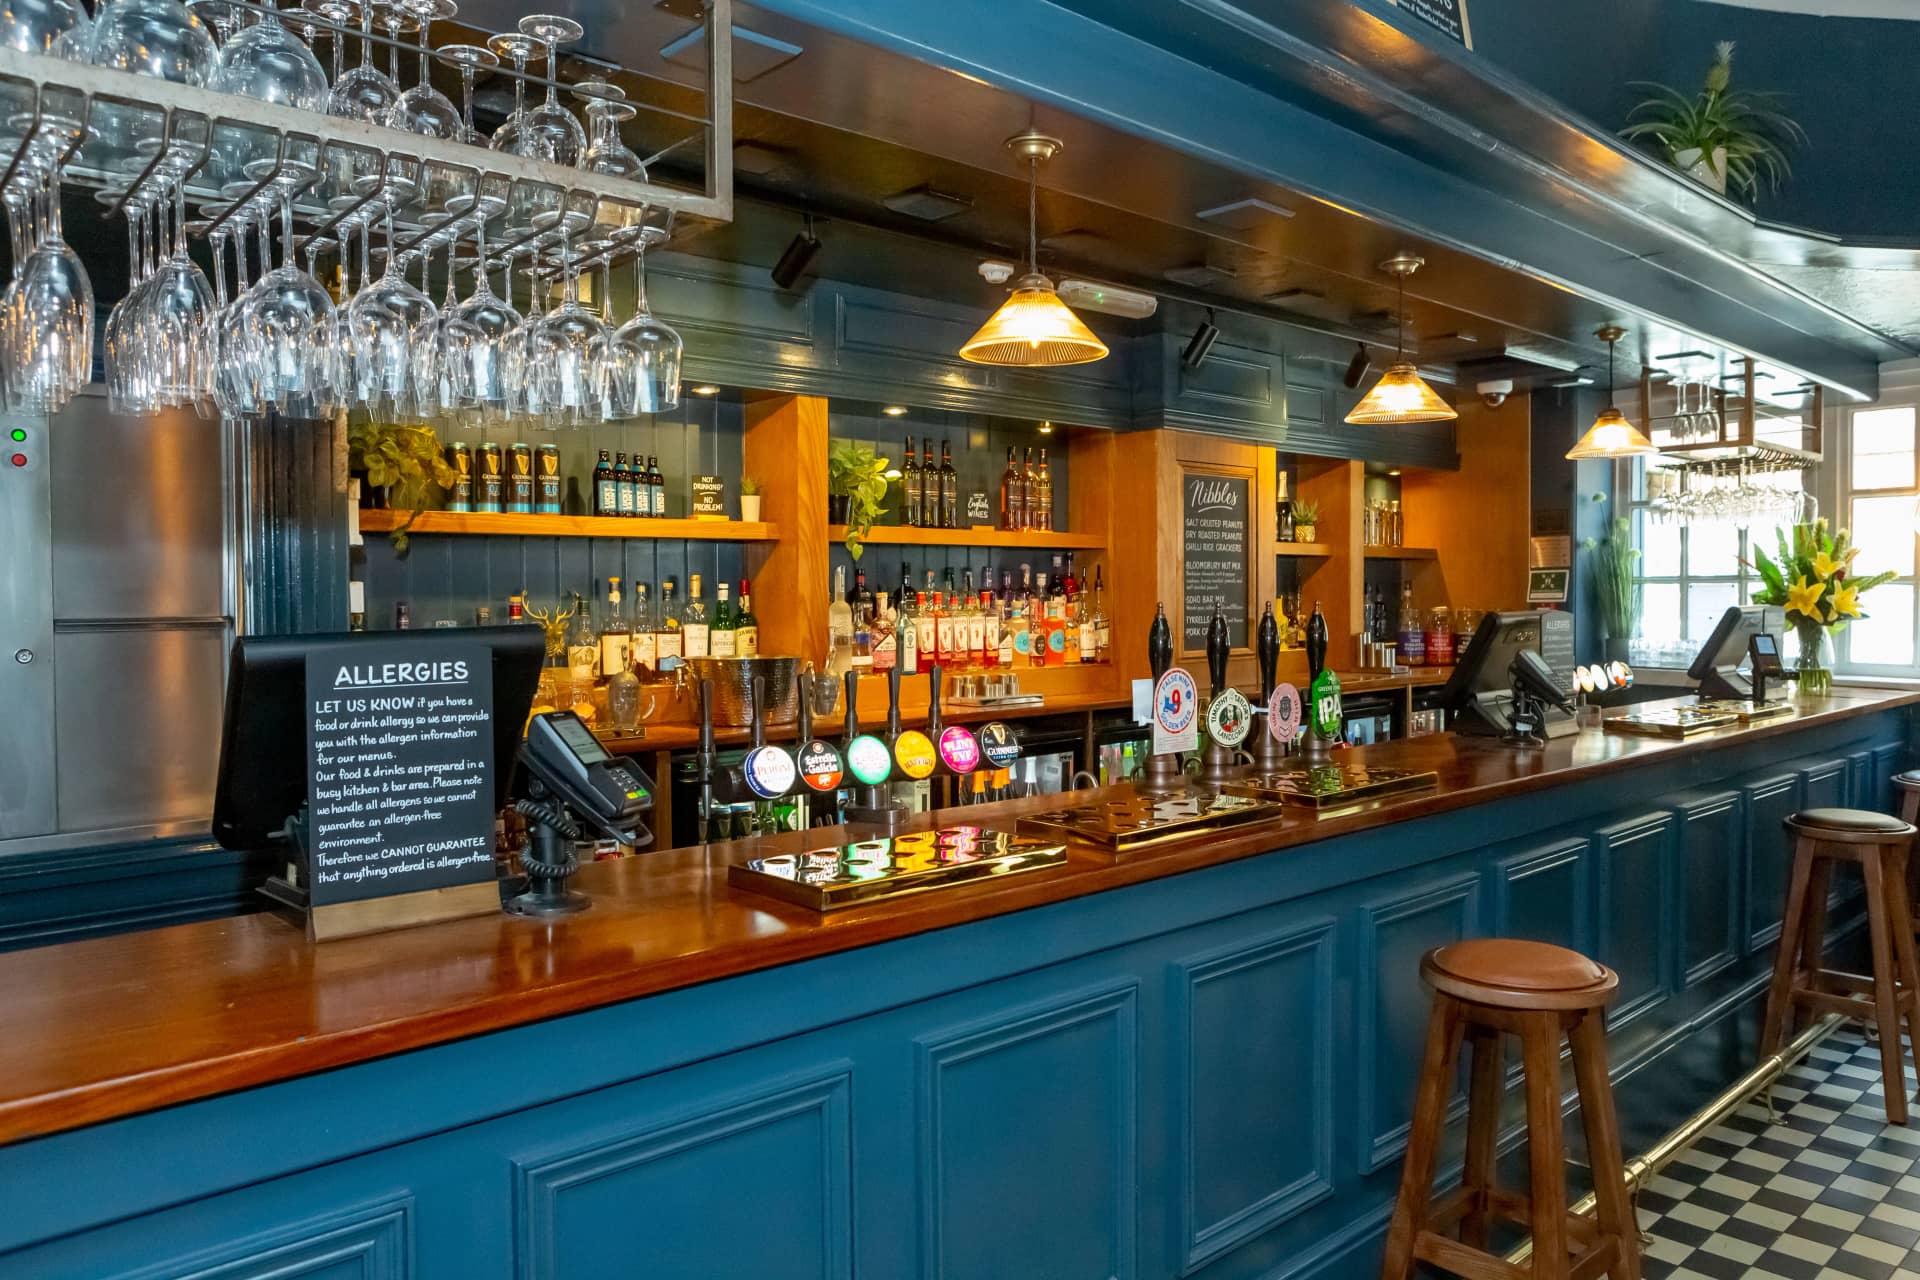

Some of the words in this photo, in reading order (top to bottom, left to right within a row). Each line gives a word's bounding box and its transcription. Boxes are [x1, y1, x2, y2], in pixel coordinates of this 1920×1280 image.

[704, 496, 713, 504] NO
[1190, 479, 1238, 508] Nibbles
[334, 661, 469, 686] ALLERGIES
[316, 700, 341, 713] LET
[347, 699, 366, 712] US
[371, 697, 415, 711] KNOW
[418, 697, 424, 707] if
[428, 700, 444, 711] you
[446, 696, 467, 706] have
[1210, 695, 1228, 722] TIMOTHY
[1318, 694, 1343, 725] IPA
[315, 719, 337, 731] food
[351, 716, 379, 729] drink
[380, 715, 414, 728] allergy
[458, 710, 489, 724] provide
[315, 741, 334, 752] you
[336, 736, 358, 746] with
[360, 734, 377, 745] the
[379, 732, 417, 745] allergen
[421, 727, 477, 740] information
[1217, 726, 1245, 741] LANDLORD
[317, 753, 333, 765] for
[358, 752, 396, 762] menus.
[805, 751, 837, 765] Estrella
[987, 745, 1023, 757] GUINNESS
[316, 771, 335, 782] Our
[339, 768, 361, 780] food
[364, 768, 371, 777] &
[373, 765, 405, 777] drinks
[424, 760, 464, 776] prepared
[467, 760, 476, 768] in
[808, 761, 839, 774] Galicia
[317, 787, 341, 800] busy
[343, 784, 379, 796] kitchen
[383, 783, 389, 792] &
[391, 781, 407, 791] bar
[409, 782, 432, 790] area.
[433, 777, 462, 788] Please
[464, 775, 482, 785] note
[331, 801, 363, 813] handle
[366, 799, 377, 810] all
[380, 797, 422, 809] allergens
[447, 790, 476, 801] cannot
[319, 820, 365, 835] guarantee
[384, 810, 442, 825] allergen-free
[319, 832, 385, 850] environment.
[317, 852, 363, 868] Therefore
[381, 844, 424, 859] CANNOT
[426, 837, 485, 853] GUARANTEE
[318, 871, 340, 883] that
[343, 867, 388, 882] anything
[389, 861, 425, 873] ordered
[427, 858, 435, 868] is
[437, 852, 493, 868] allergen-free.
